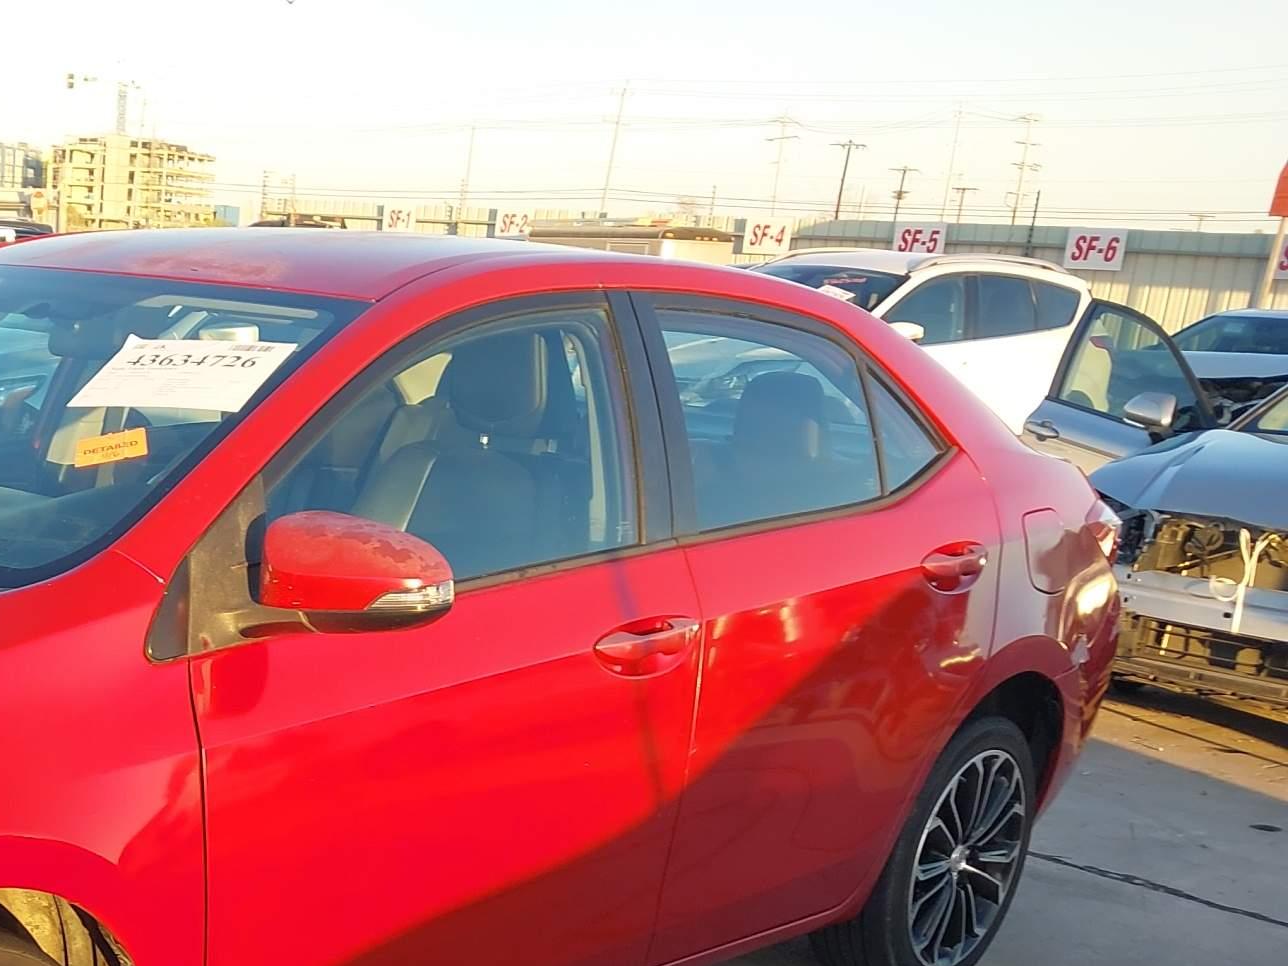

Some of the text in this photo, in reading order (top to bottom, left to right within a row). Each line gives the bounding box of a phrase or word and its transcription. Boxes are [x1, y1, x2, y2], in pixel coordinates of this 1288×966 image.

[388, 209, 411, 228] SF-1
[500, 213, 528, 233] SF-2
[749, 223, 786, 248] SF-4
[898, 228, 940, 254] SF-5
[1071, 235, 1120, 262] SF-6
[127, 353, 261, 368] 43634726
[83, 440, 138, 455] DETAILED
